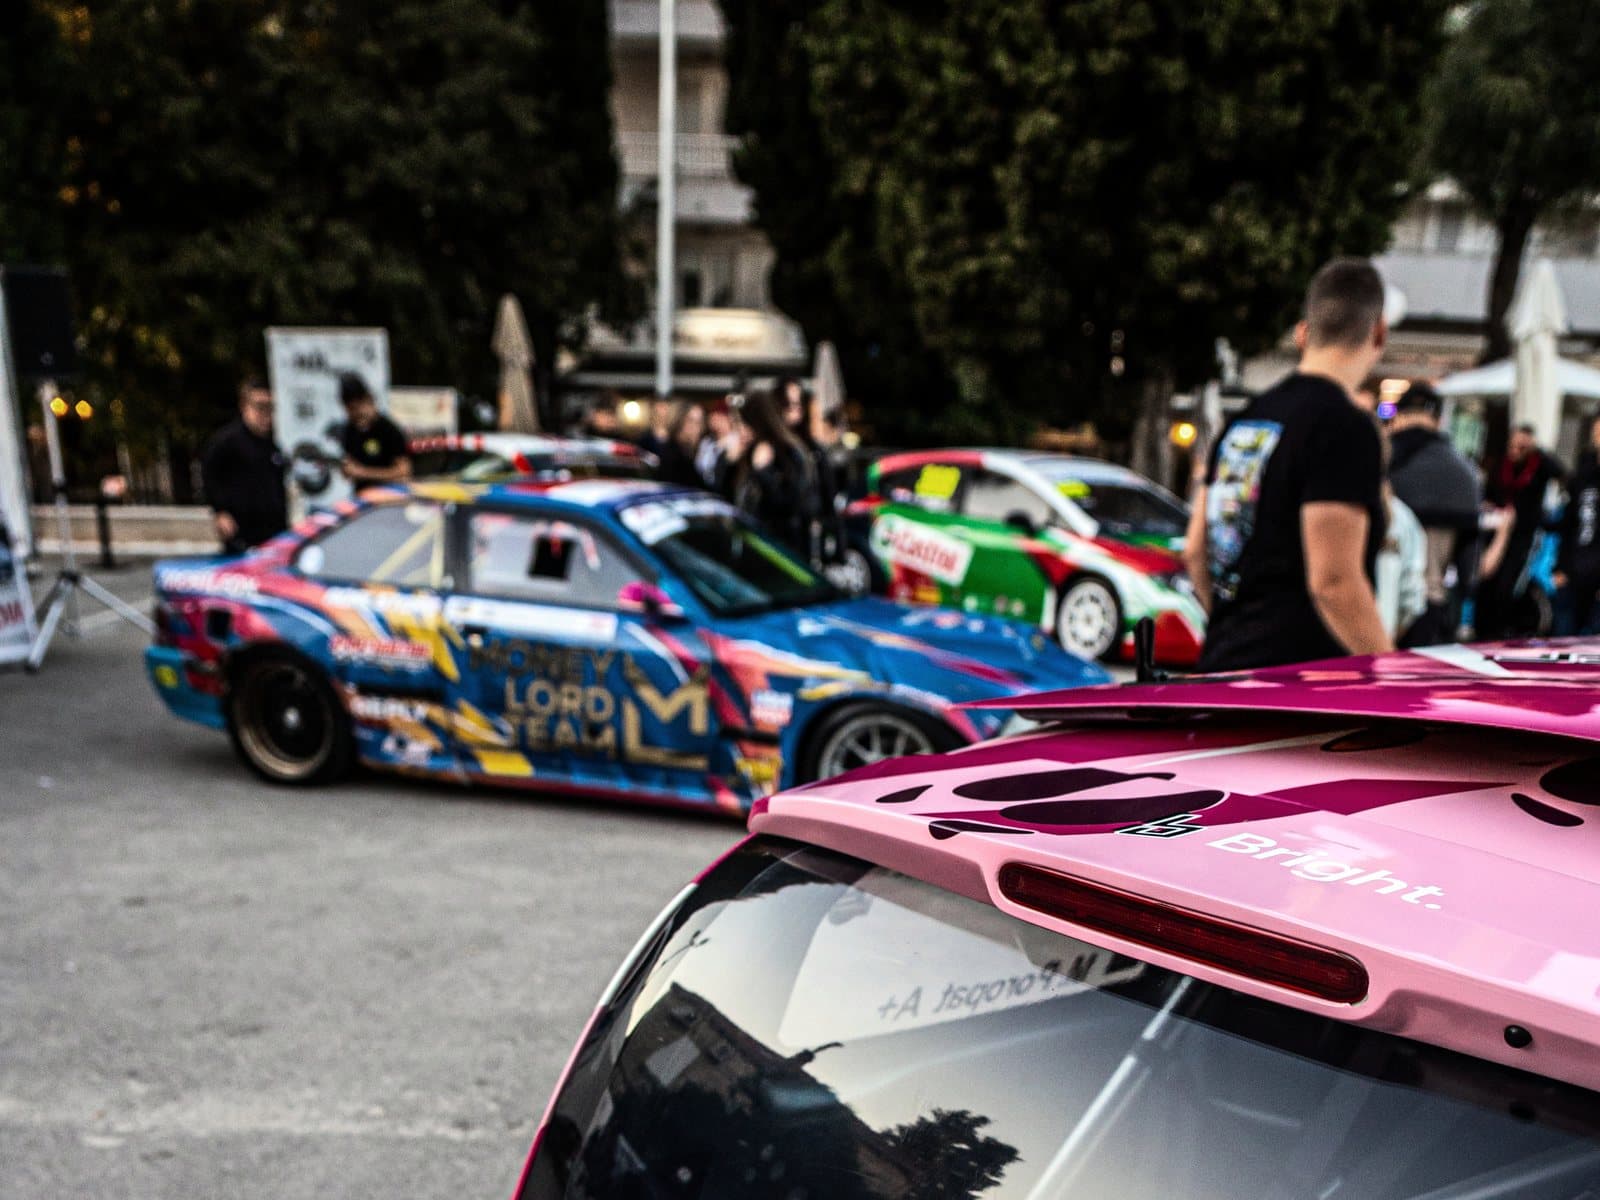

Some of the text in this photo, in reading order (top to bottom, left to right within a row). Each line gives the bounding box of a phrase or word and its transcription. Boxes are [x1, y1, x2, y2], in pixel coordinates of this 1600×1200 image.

[470, 639, 615, 685] MONEY
[505, 677, 616, 723] LORD
[505, 711, 618, 759] TEAM
[1205, 832, 1447, 911] Bright.
